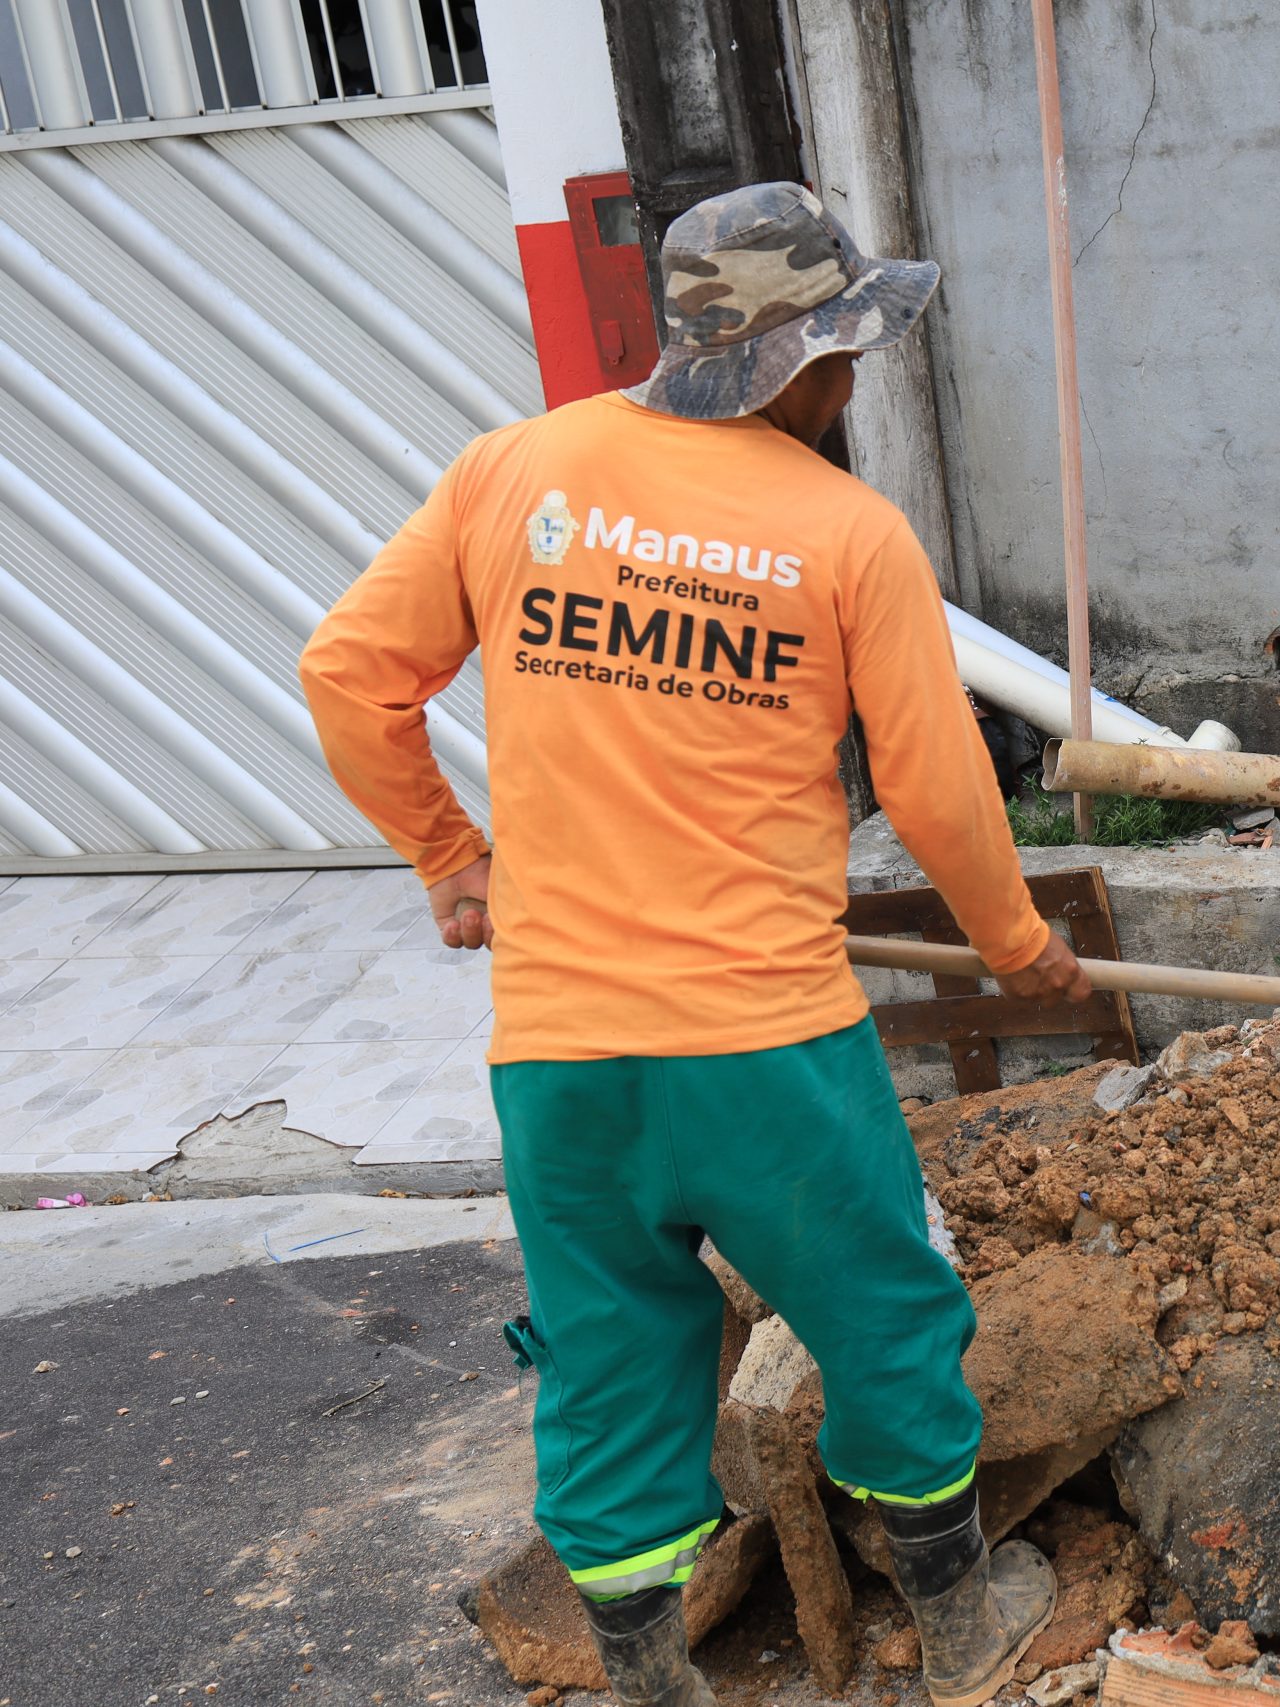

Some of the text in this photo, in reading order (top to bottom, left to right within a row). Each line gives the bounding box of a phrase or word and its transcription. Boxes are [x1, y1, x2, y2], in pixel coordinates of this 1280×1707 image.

[584, 507, 802, 588] Manaus
[617, 565, 760, 611] Prefeitura
[518, 587, 805, 682] SEMINF
[514, 651, 790, 710] Secretaria de Obras
